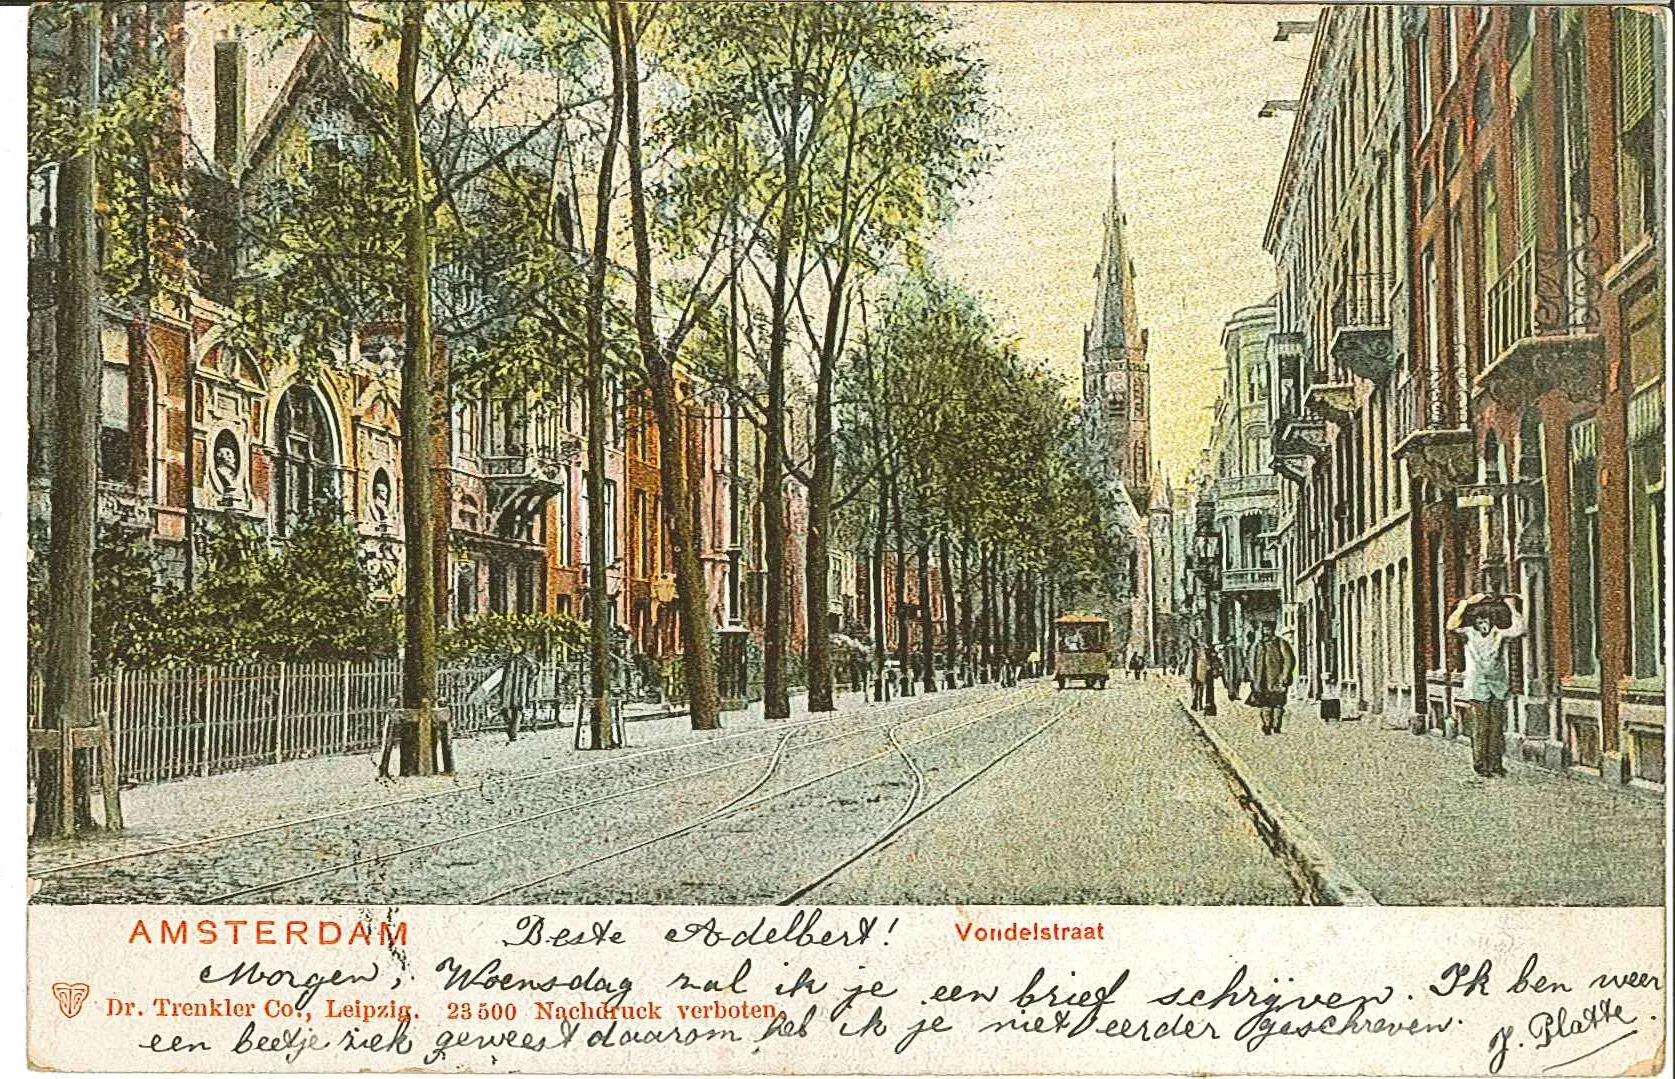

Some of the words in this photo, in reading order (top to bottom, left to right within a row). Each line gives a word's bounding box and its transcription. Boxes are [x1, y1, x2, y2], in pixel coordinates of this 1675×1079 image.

[128, 919, 408, 945] AMSTERDAM
[502, 914, 626, 947] Beste
[955, 922, 1105, 942] Vondelstraat
[106, 998, 143, 1017] Dr.
[153, 998, 256, 1017] Trenkler
[325, 999, 420, 1022] Leipzig.
[535, 1001, 662, 1020] Nachdruck
[435, 956, 634, 1011] Woensdag
[667, 958, 751, 994] zal
[775, 961, 828, 998] ik
[831, 965, 898, 1022] je
[929, 985, 999, 1003] een
[1010, 967, 1130, 1038] brief
[1430, 959, 1492, 997] Ik
[1507, 953, 1572, 993] ben
[1589, 971, 1664, 992] weer
[139, 1033, 211, 1053] een
[231, 1021, 330, 1064] beetje
[339, 1012, 413, 1054] ziek
[424, 1015, 581, 1065] geweest
[587, 1020, 742, 1048] daarom
[754, 1004, 818, 1043] heb
[839, 1006, 887, 1038] ik
[895, 1015, 953, 1055] je
[978, 1009, 1071, 1035] niet
[1096, 1014, 1221, 1041] eerder
